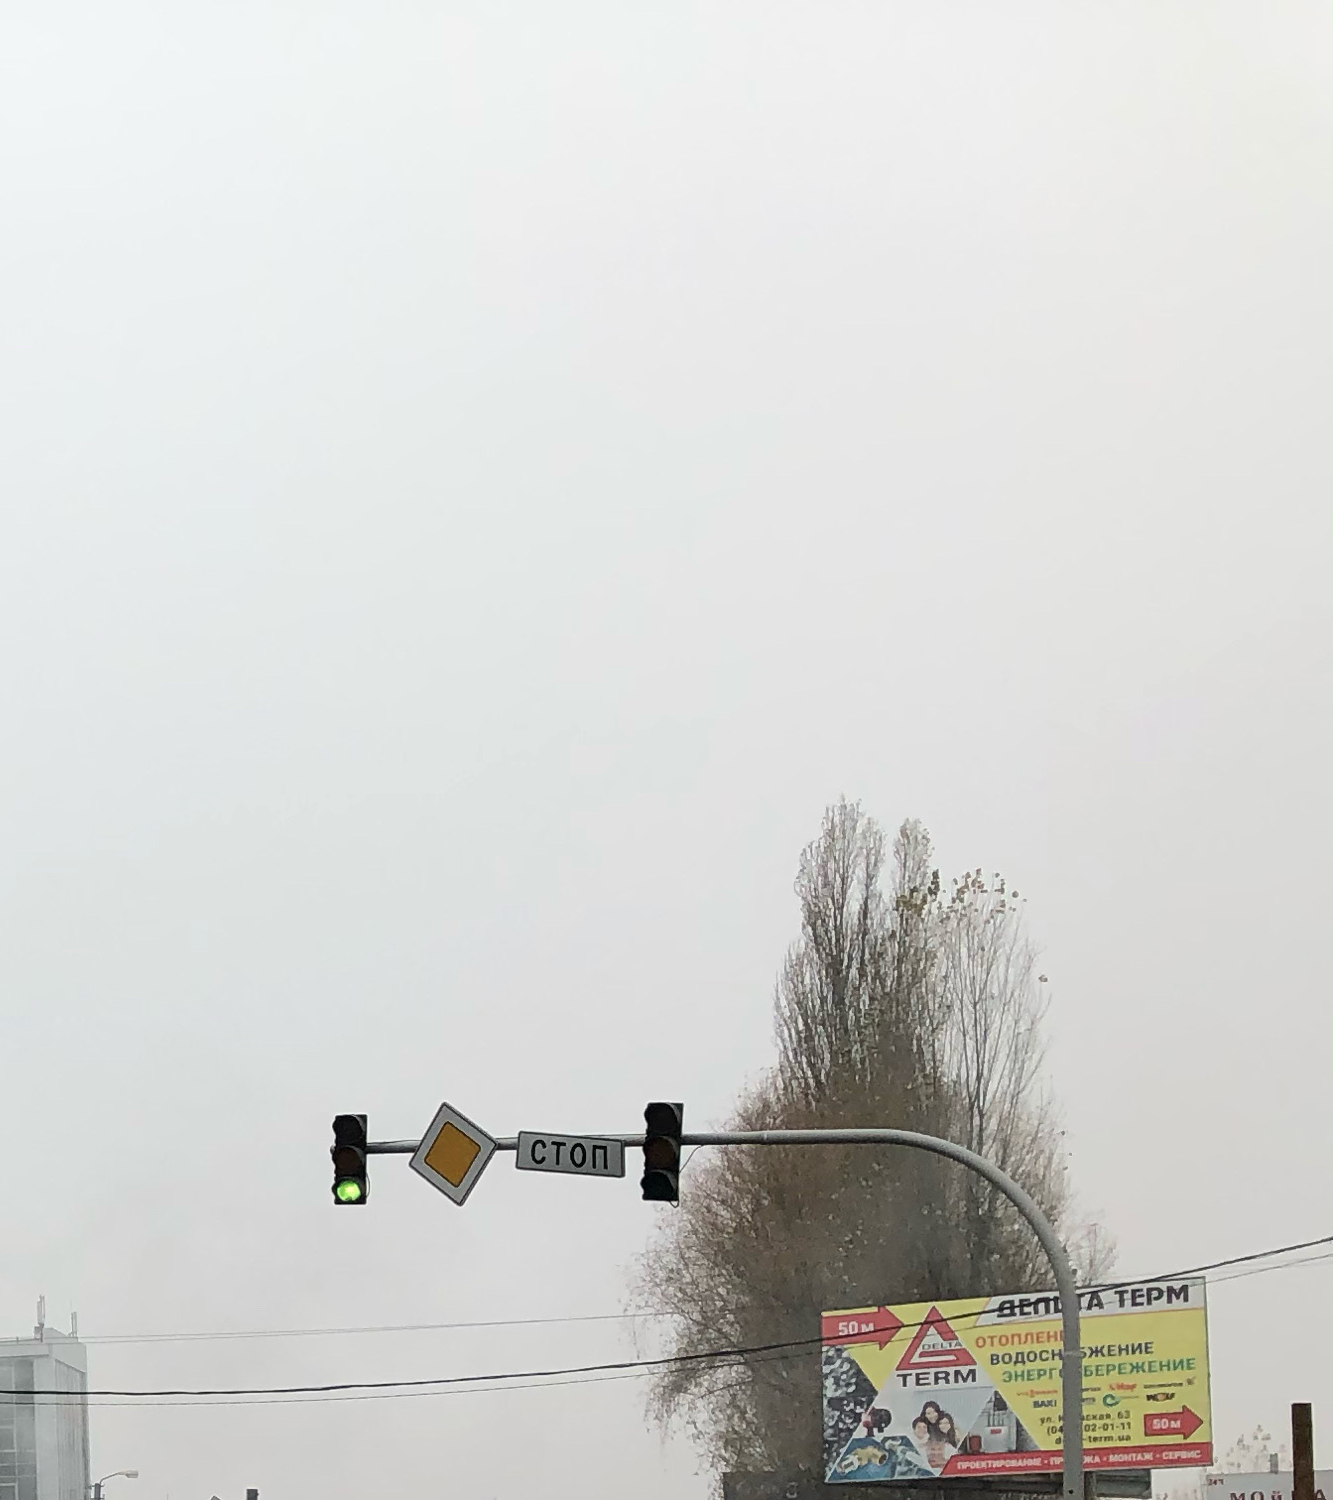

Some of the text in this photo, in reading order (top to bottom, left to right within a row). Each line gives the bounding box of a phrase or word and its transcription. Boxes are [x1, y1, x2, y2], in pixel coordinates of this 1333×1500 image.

[531, 1139, 608, 1170] СТОП
[1114, 1284, 1190, 1308] ТЕРМ
[838, 1320, 859, 1336] 50
[922, 1341, 962, 1351] DELTA
[975, 1330, 1063, 1349] ОТОПЛЕН
[990, 1341, 1155, 1366] ВОДОСНБЖЕНИЕ
[896, 1368, 977, 1388] TERM
[1001, 1358, 1197, 1383] ЭНЕРГБЕРЕЖЕНИЕ
[1109, 1452, 1153, 1463] МОНТАЖ
[1162, 1449, 1202, 1460] СЕРВИС
